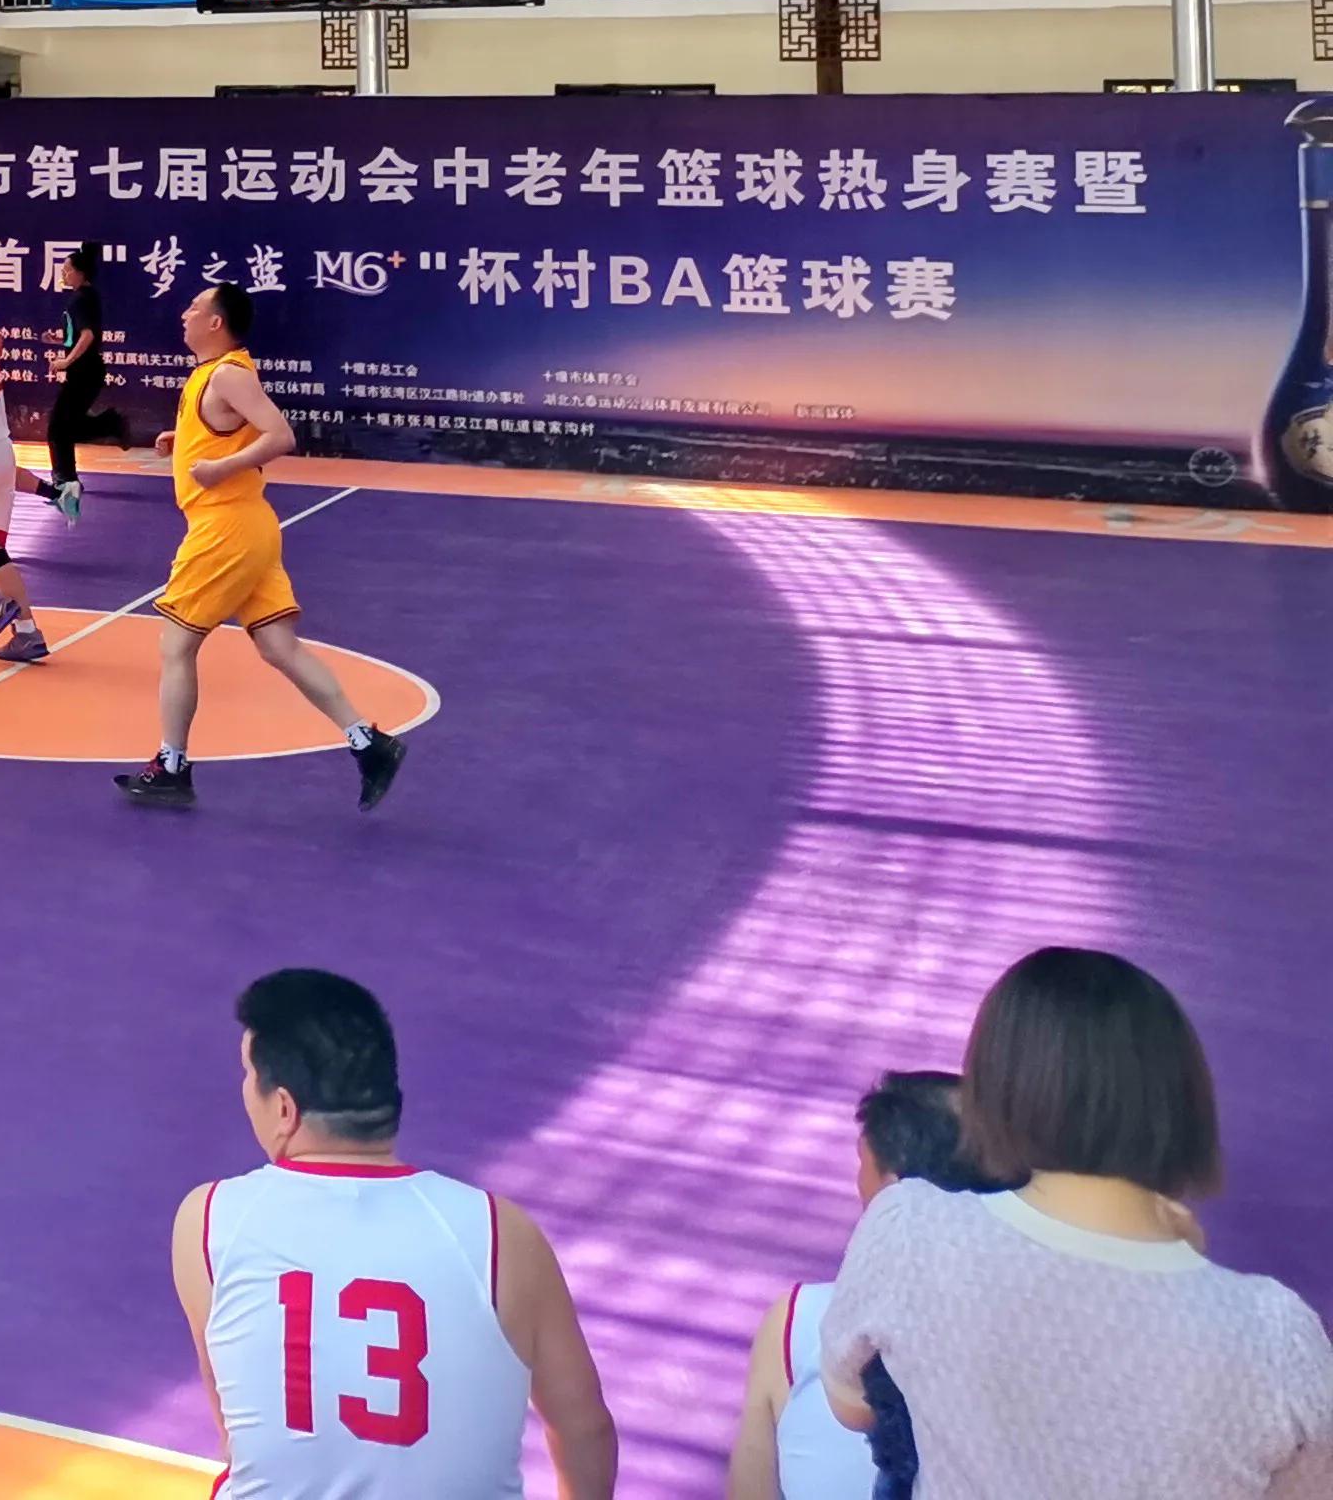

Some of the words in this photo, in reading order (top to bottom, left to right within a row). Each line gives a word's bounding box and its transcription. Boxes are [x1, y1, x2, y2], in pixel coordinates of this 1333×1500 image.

[340, 361, 419, 378] 十堰市总工会
[103, 372, 127, 387] 中心
[277, 1270, 429, 1448] 13
